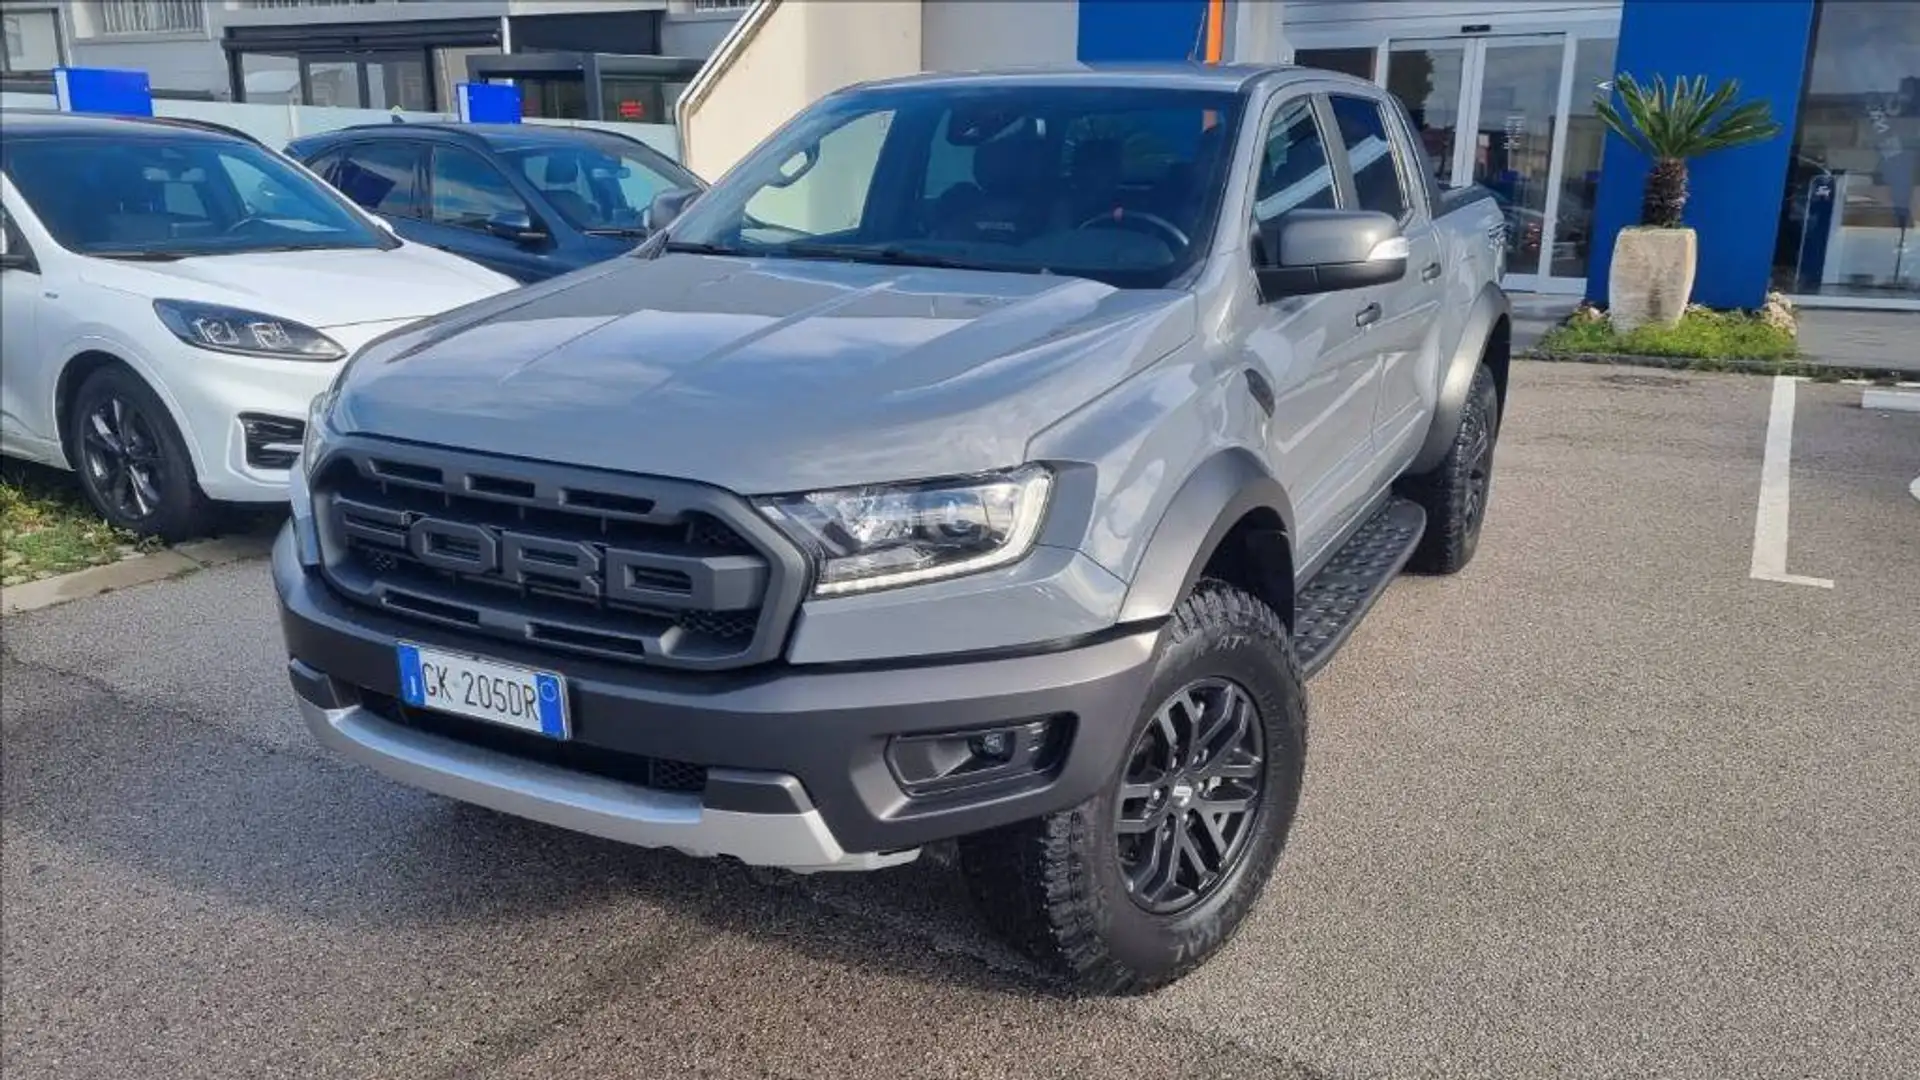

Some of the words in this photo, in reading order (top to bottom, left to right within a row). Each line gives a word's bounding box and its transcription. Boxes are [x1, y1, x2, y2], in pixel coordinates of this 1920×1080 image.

[333, 495, 769, 612] FORD
[421, 662, 453, 703] GK
[461, 671, 539, 721] 205DR
